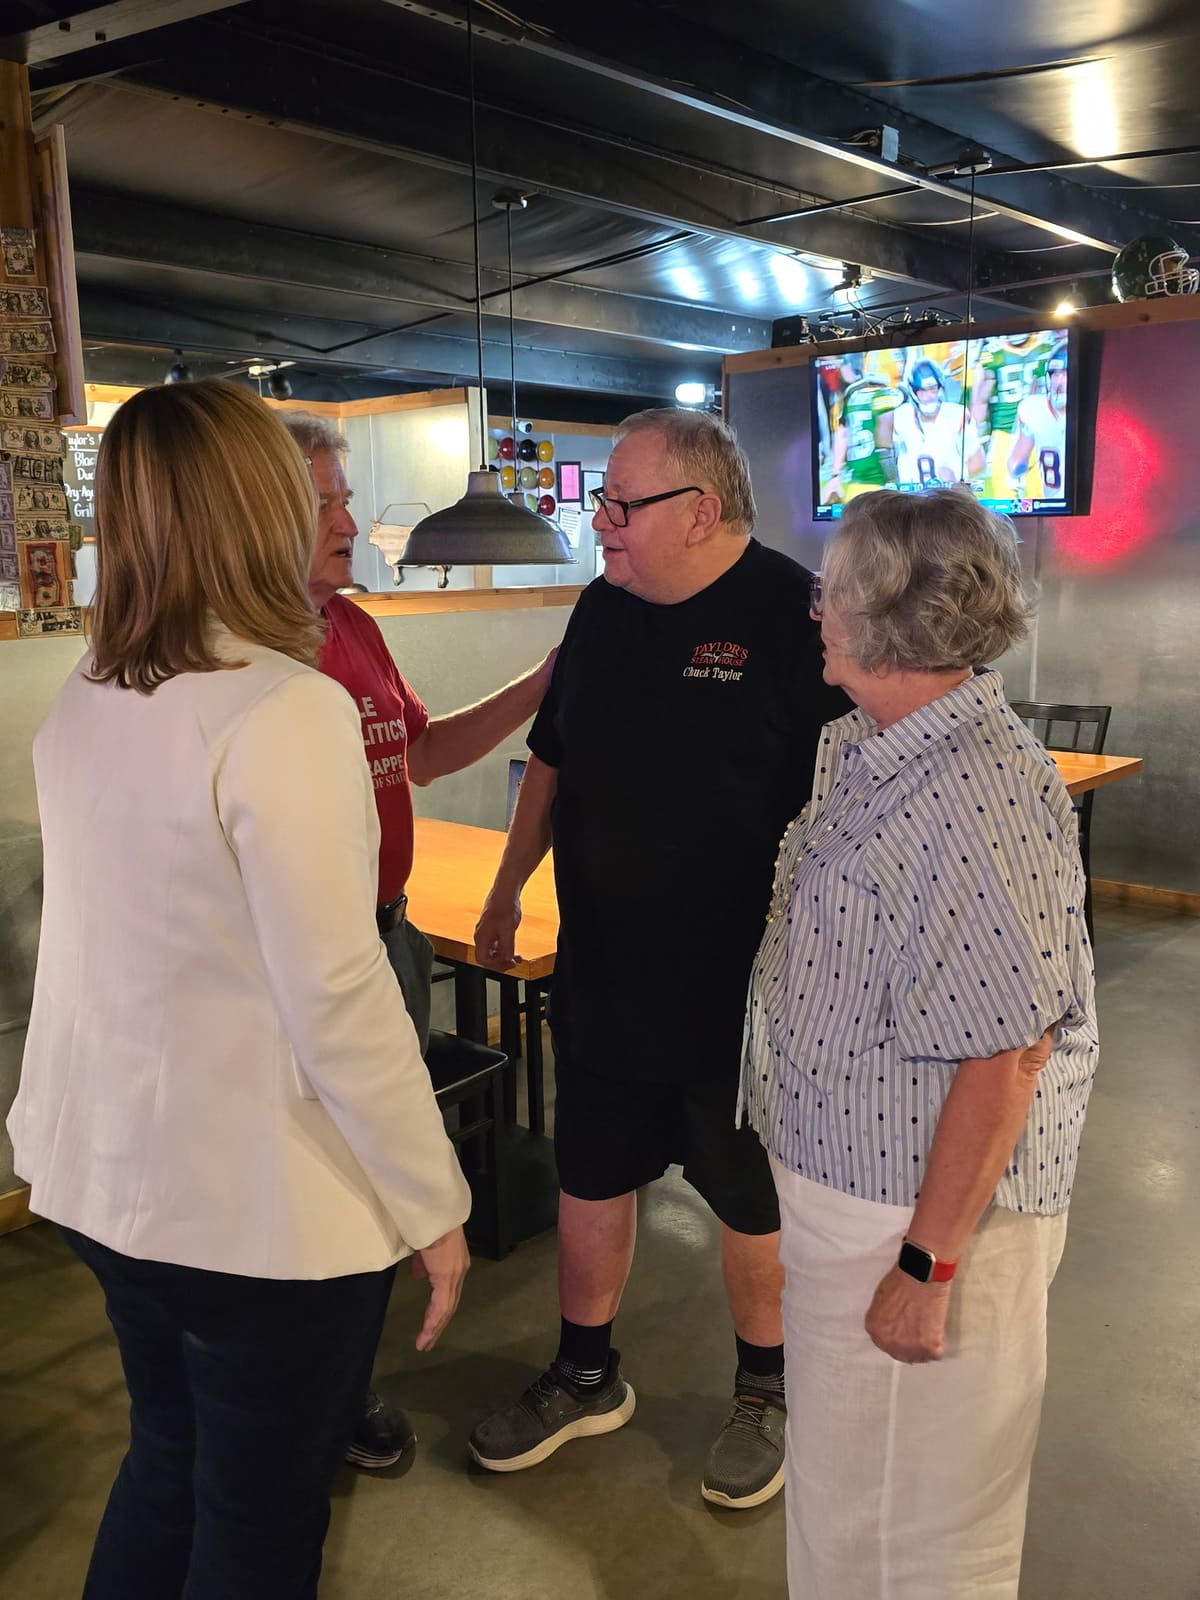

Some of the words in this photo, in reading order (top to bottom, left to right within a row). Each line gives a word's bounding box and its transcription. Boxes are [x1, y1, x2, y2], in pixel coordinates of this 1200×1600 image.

[1039, 449, 1061, 489] 8
[693, 641, 749, 660] TAYLOR'S
[682, 666, 711, 678] Chuck
[712, 667, 743, 682] Taylor
